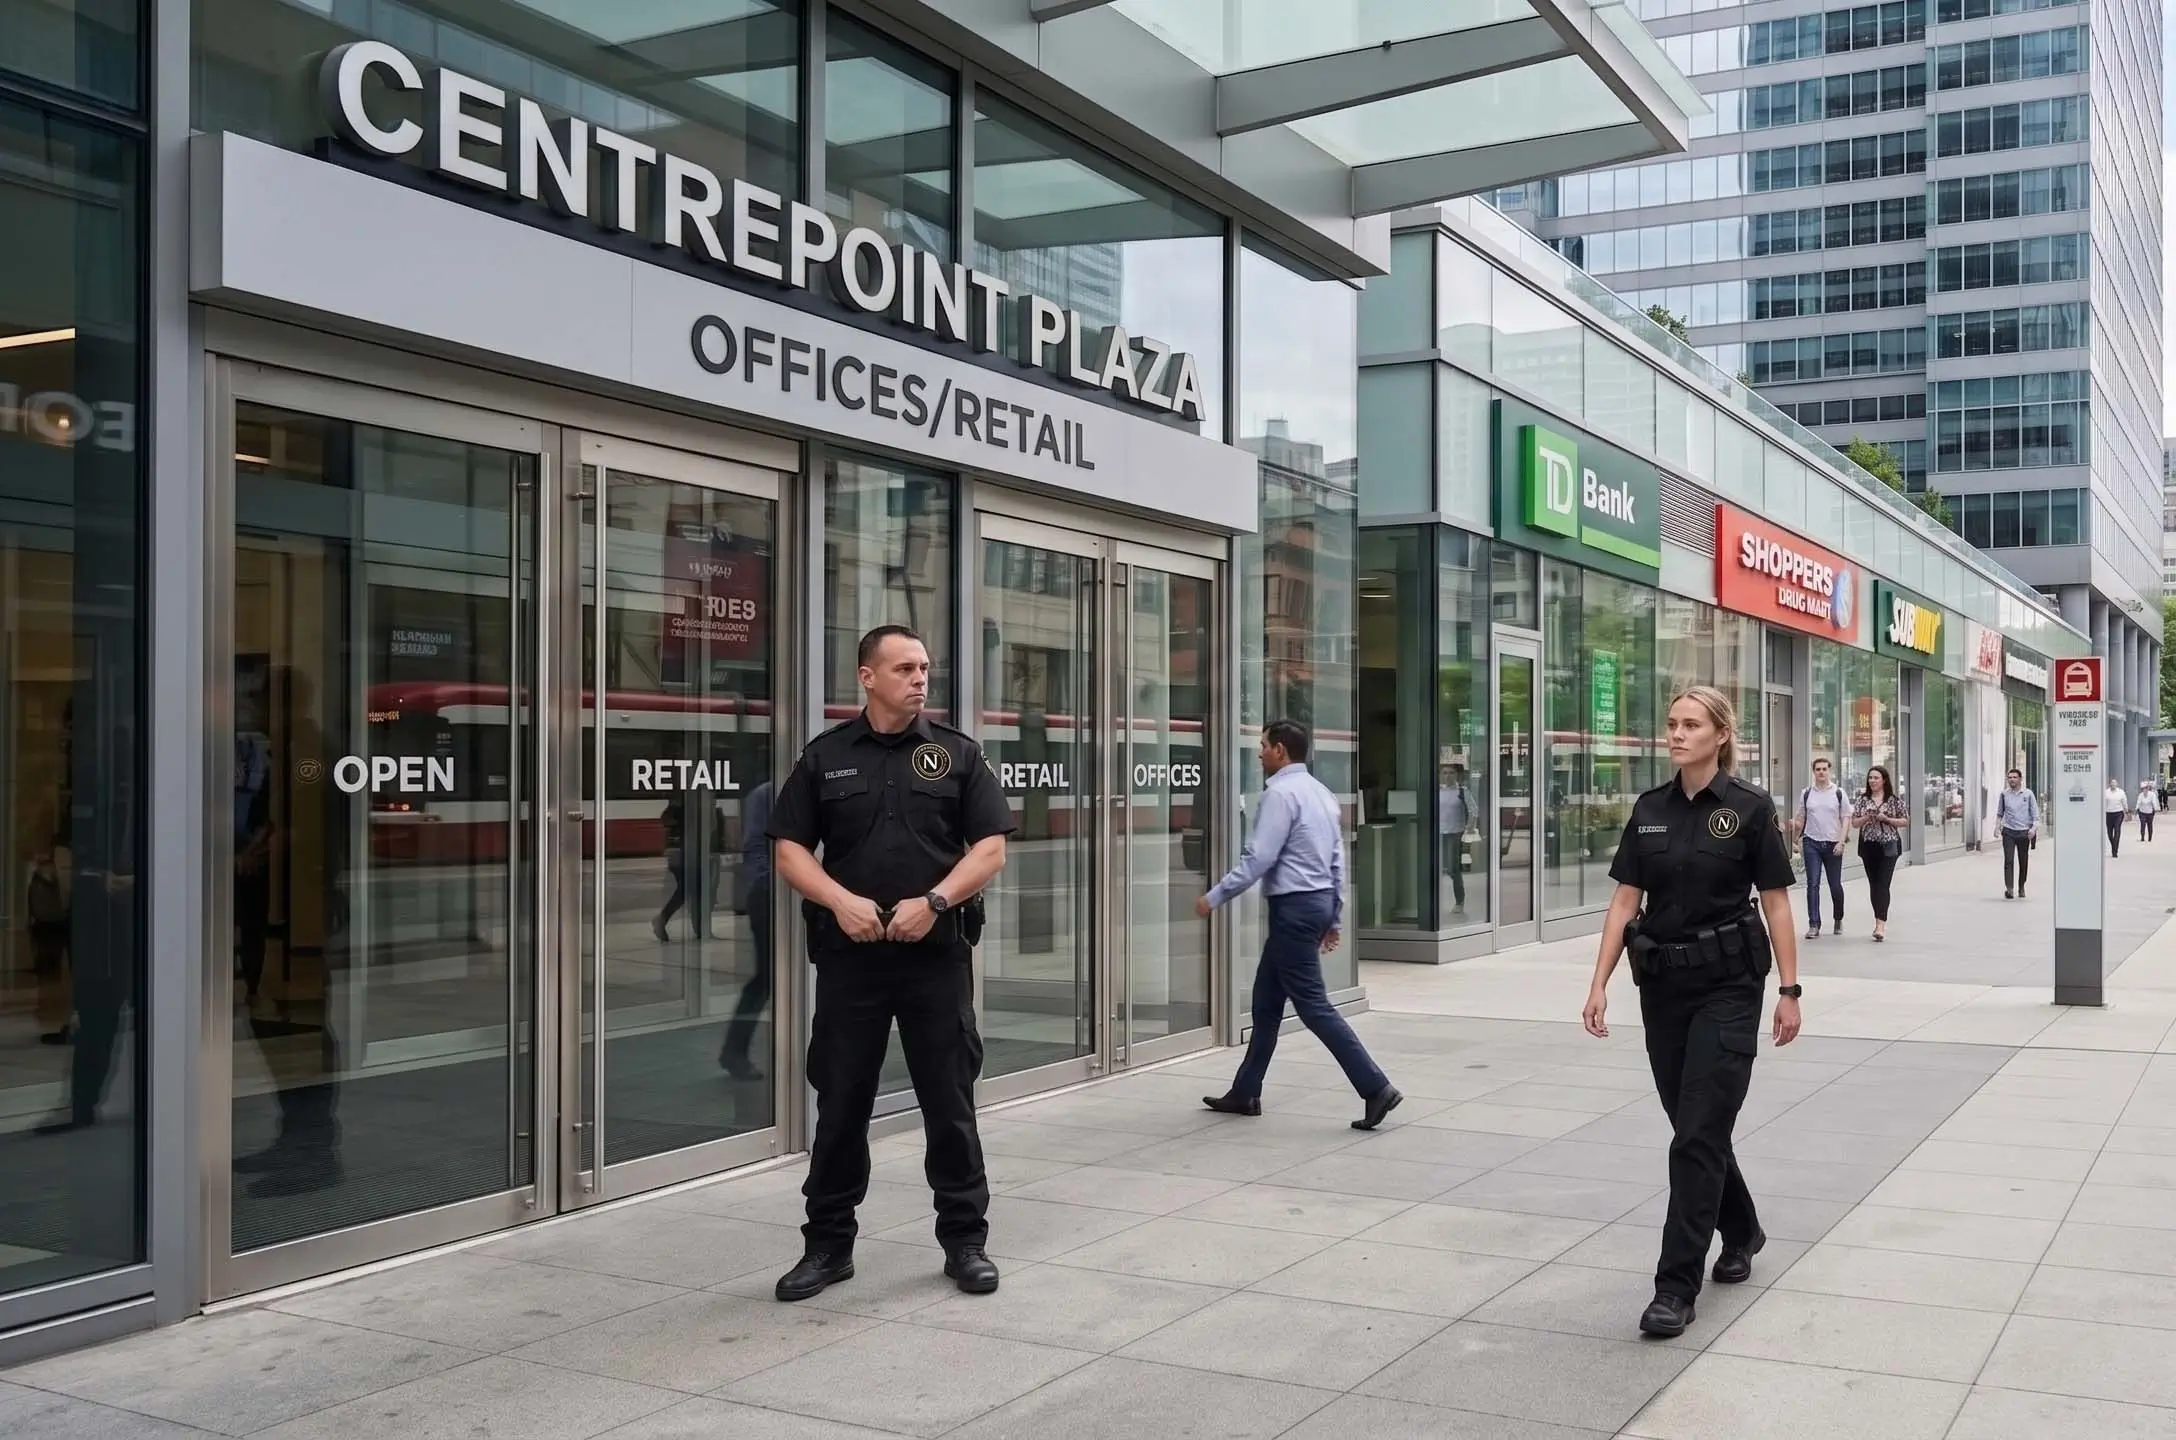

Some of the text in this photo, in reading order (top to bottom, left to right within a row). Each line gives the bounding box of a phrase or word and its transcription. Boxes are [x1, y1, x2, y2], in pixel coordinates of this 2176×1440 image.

[335, 40, 1206, 421] CENTREPOINT PLAZA
[691, 314, 1095, 471] OFFICES/RETAIL
[1539, 445, 1635, 524] TD Bank
[1740, 532, 1834, 597] SHOPPERS
[1778, 586, 1806, 612] DRUG
[333, 755, 455, 793] OPEN
[632, 759, 740, 790] RETAIL
[923, 753, 938, 770] N
[1001, 763, 1070, 787] RETAIL
[1134, 764, 1201, 787] OFFICES
[1718, 816, 1730, 830] N
